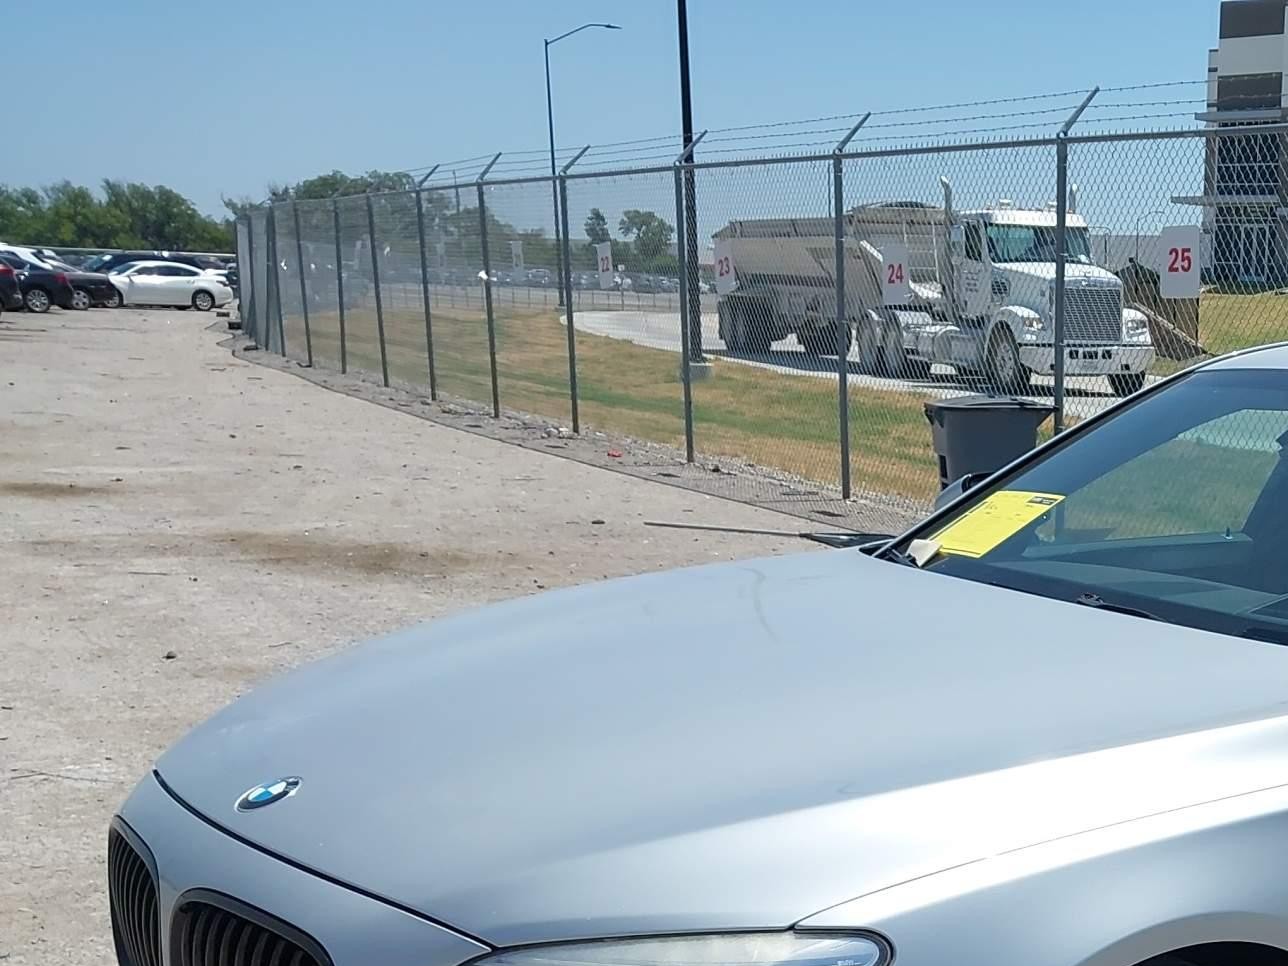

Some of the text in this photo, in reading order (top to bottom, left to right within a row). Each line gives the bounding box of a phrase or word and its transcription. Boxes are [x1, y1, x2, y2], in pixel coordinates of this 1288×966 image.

[601, 256, 610, 272] 22
[718, 257, 730, 277] 23
[1168, 248, 1192, 272] 25
[887, 263, 904, 284] 24
